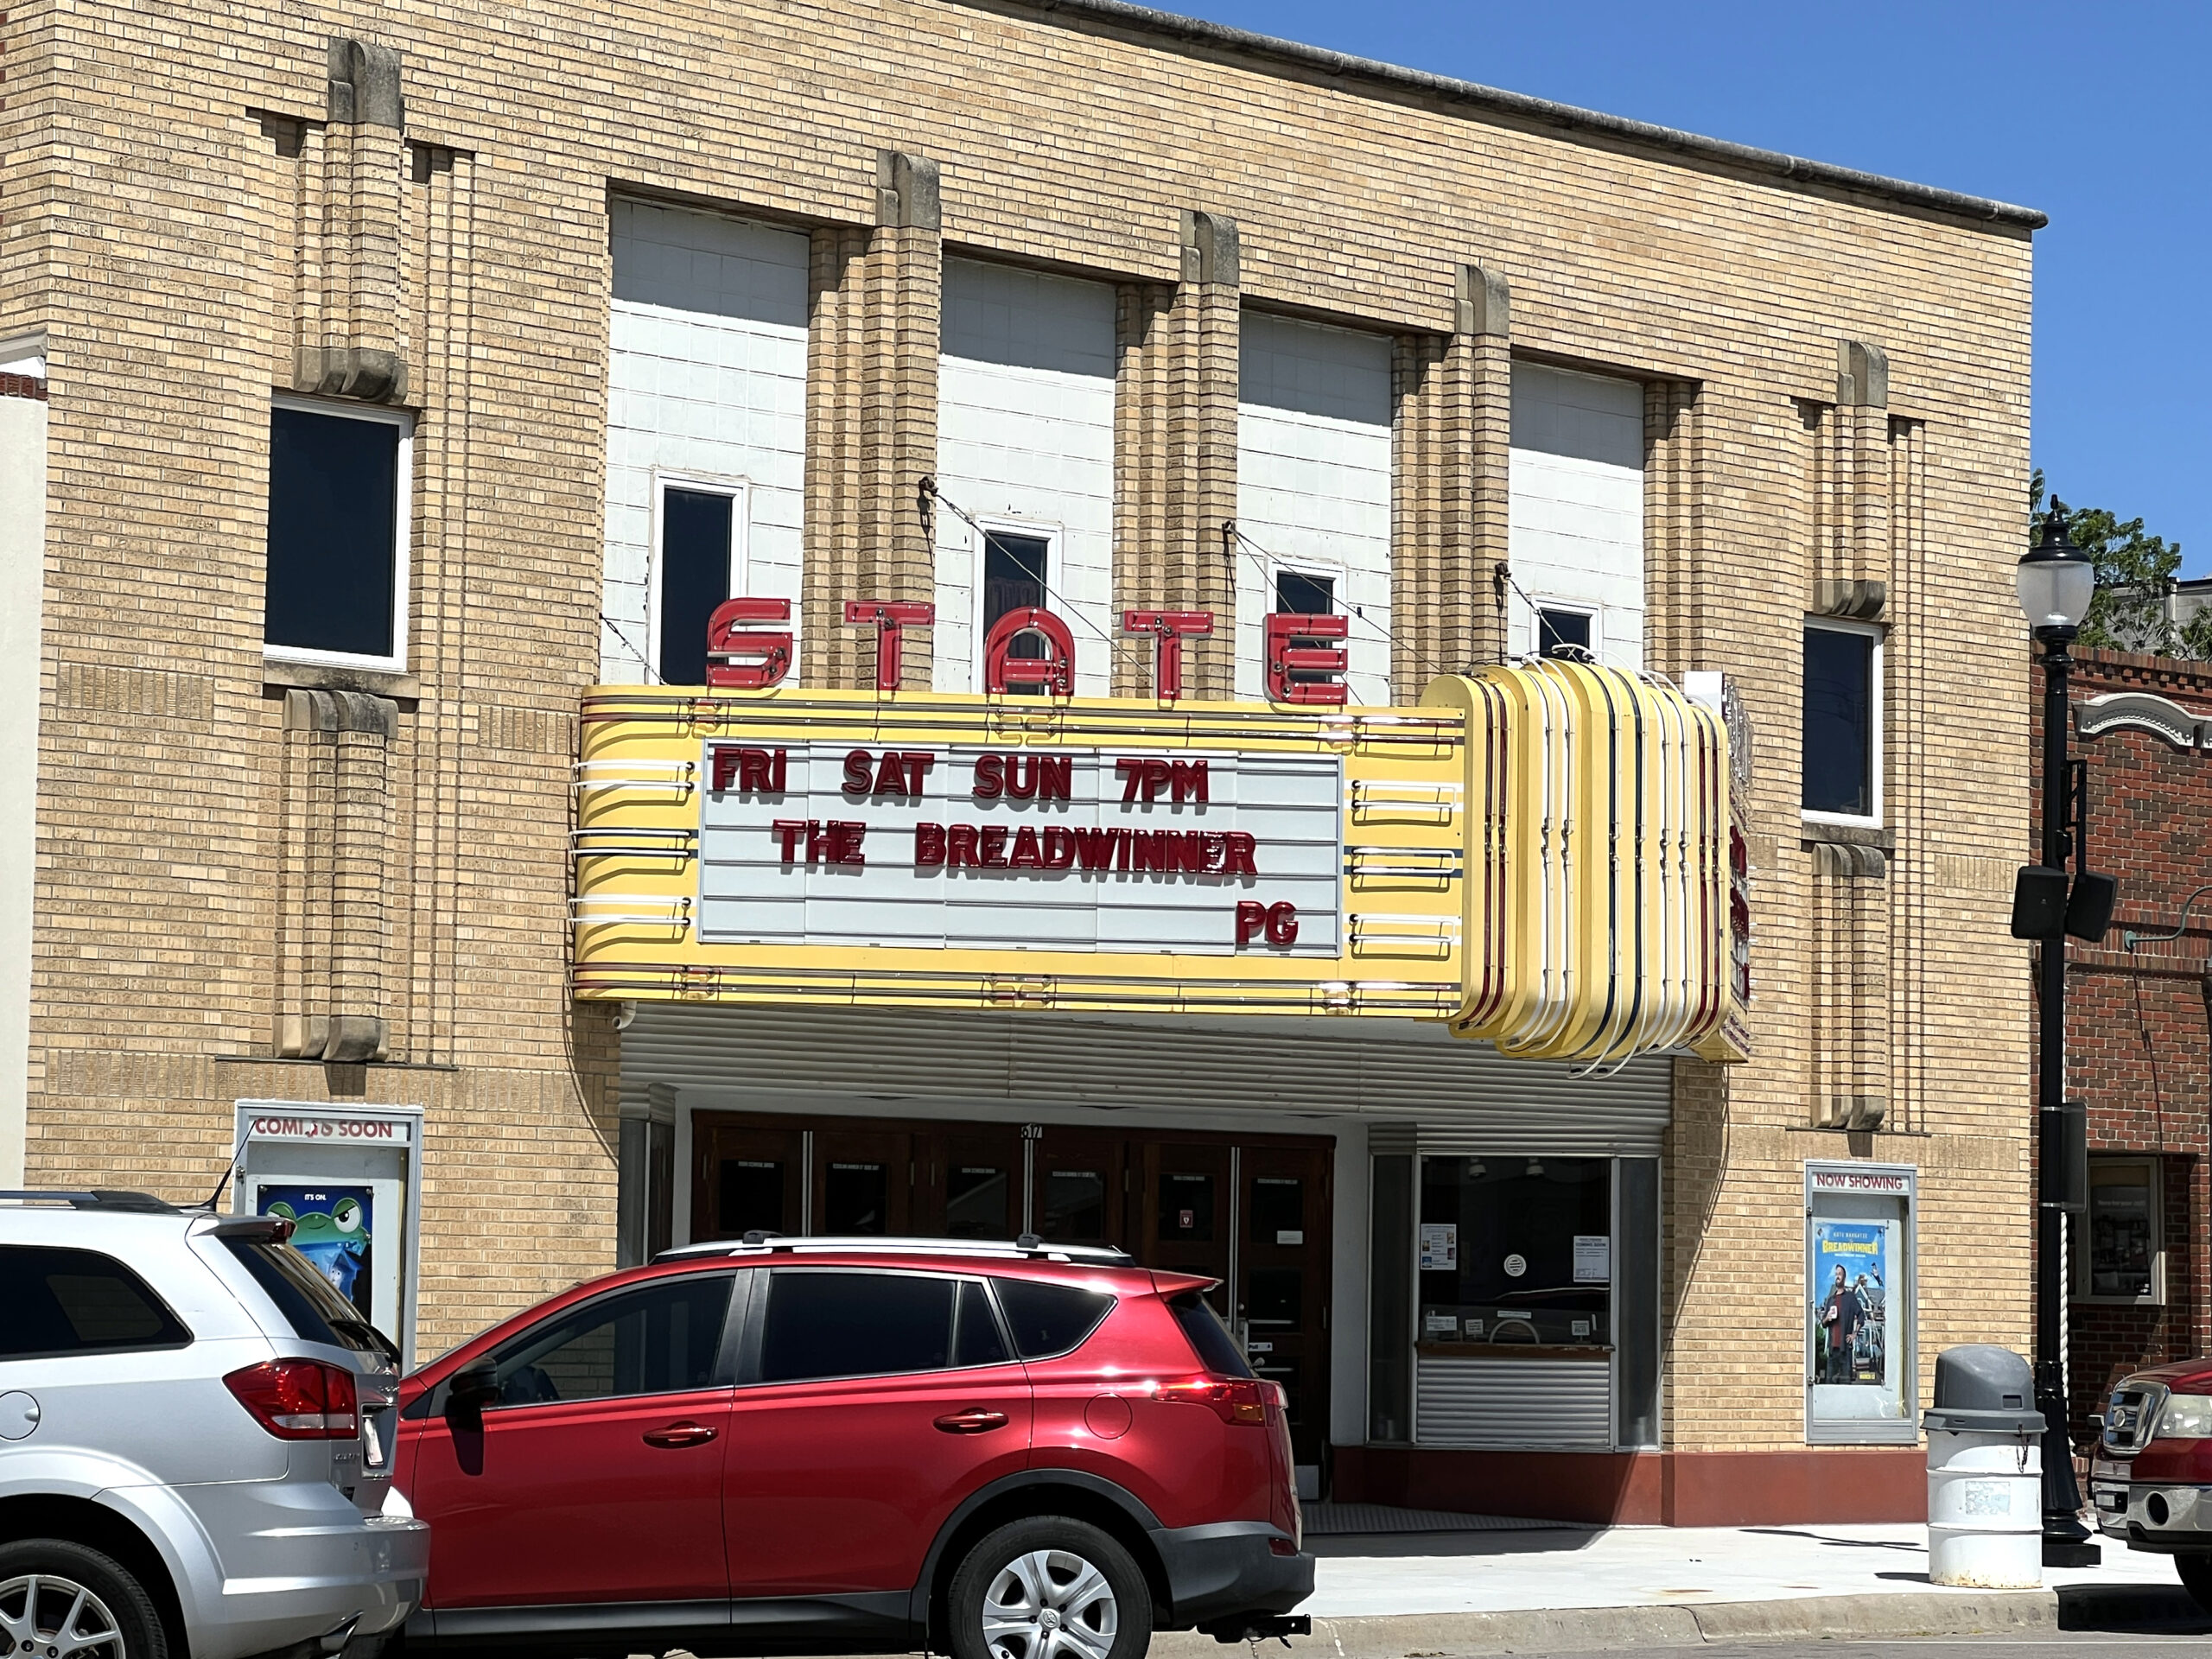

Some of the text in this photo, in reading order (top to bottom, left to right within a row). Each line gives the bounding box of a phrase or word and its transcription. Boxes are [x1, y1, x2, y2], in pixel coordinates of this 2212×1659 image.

[705, 597, 1351, 706] STATE
[712, 747, 1209, 803] FRI SAT SUN 7PM
[772, 819, 1258, 876] THE BREADWINNER
[1236, 900, 1299, 946] PG
[338, 1121, 393, 1138] SOON
[1816, 1173, 1903, 1190] NOW SHOWING
[1821, 1239, 1878, 1255] BREADWINNER
